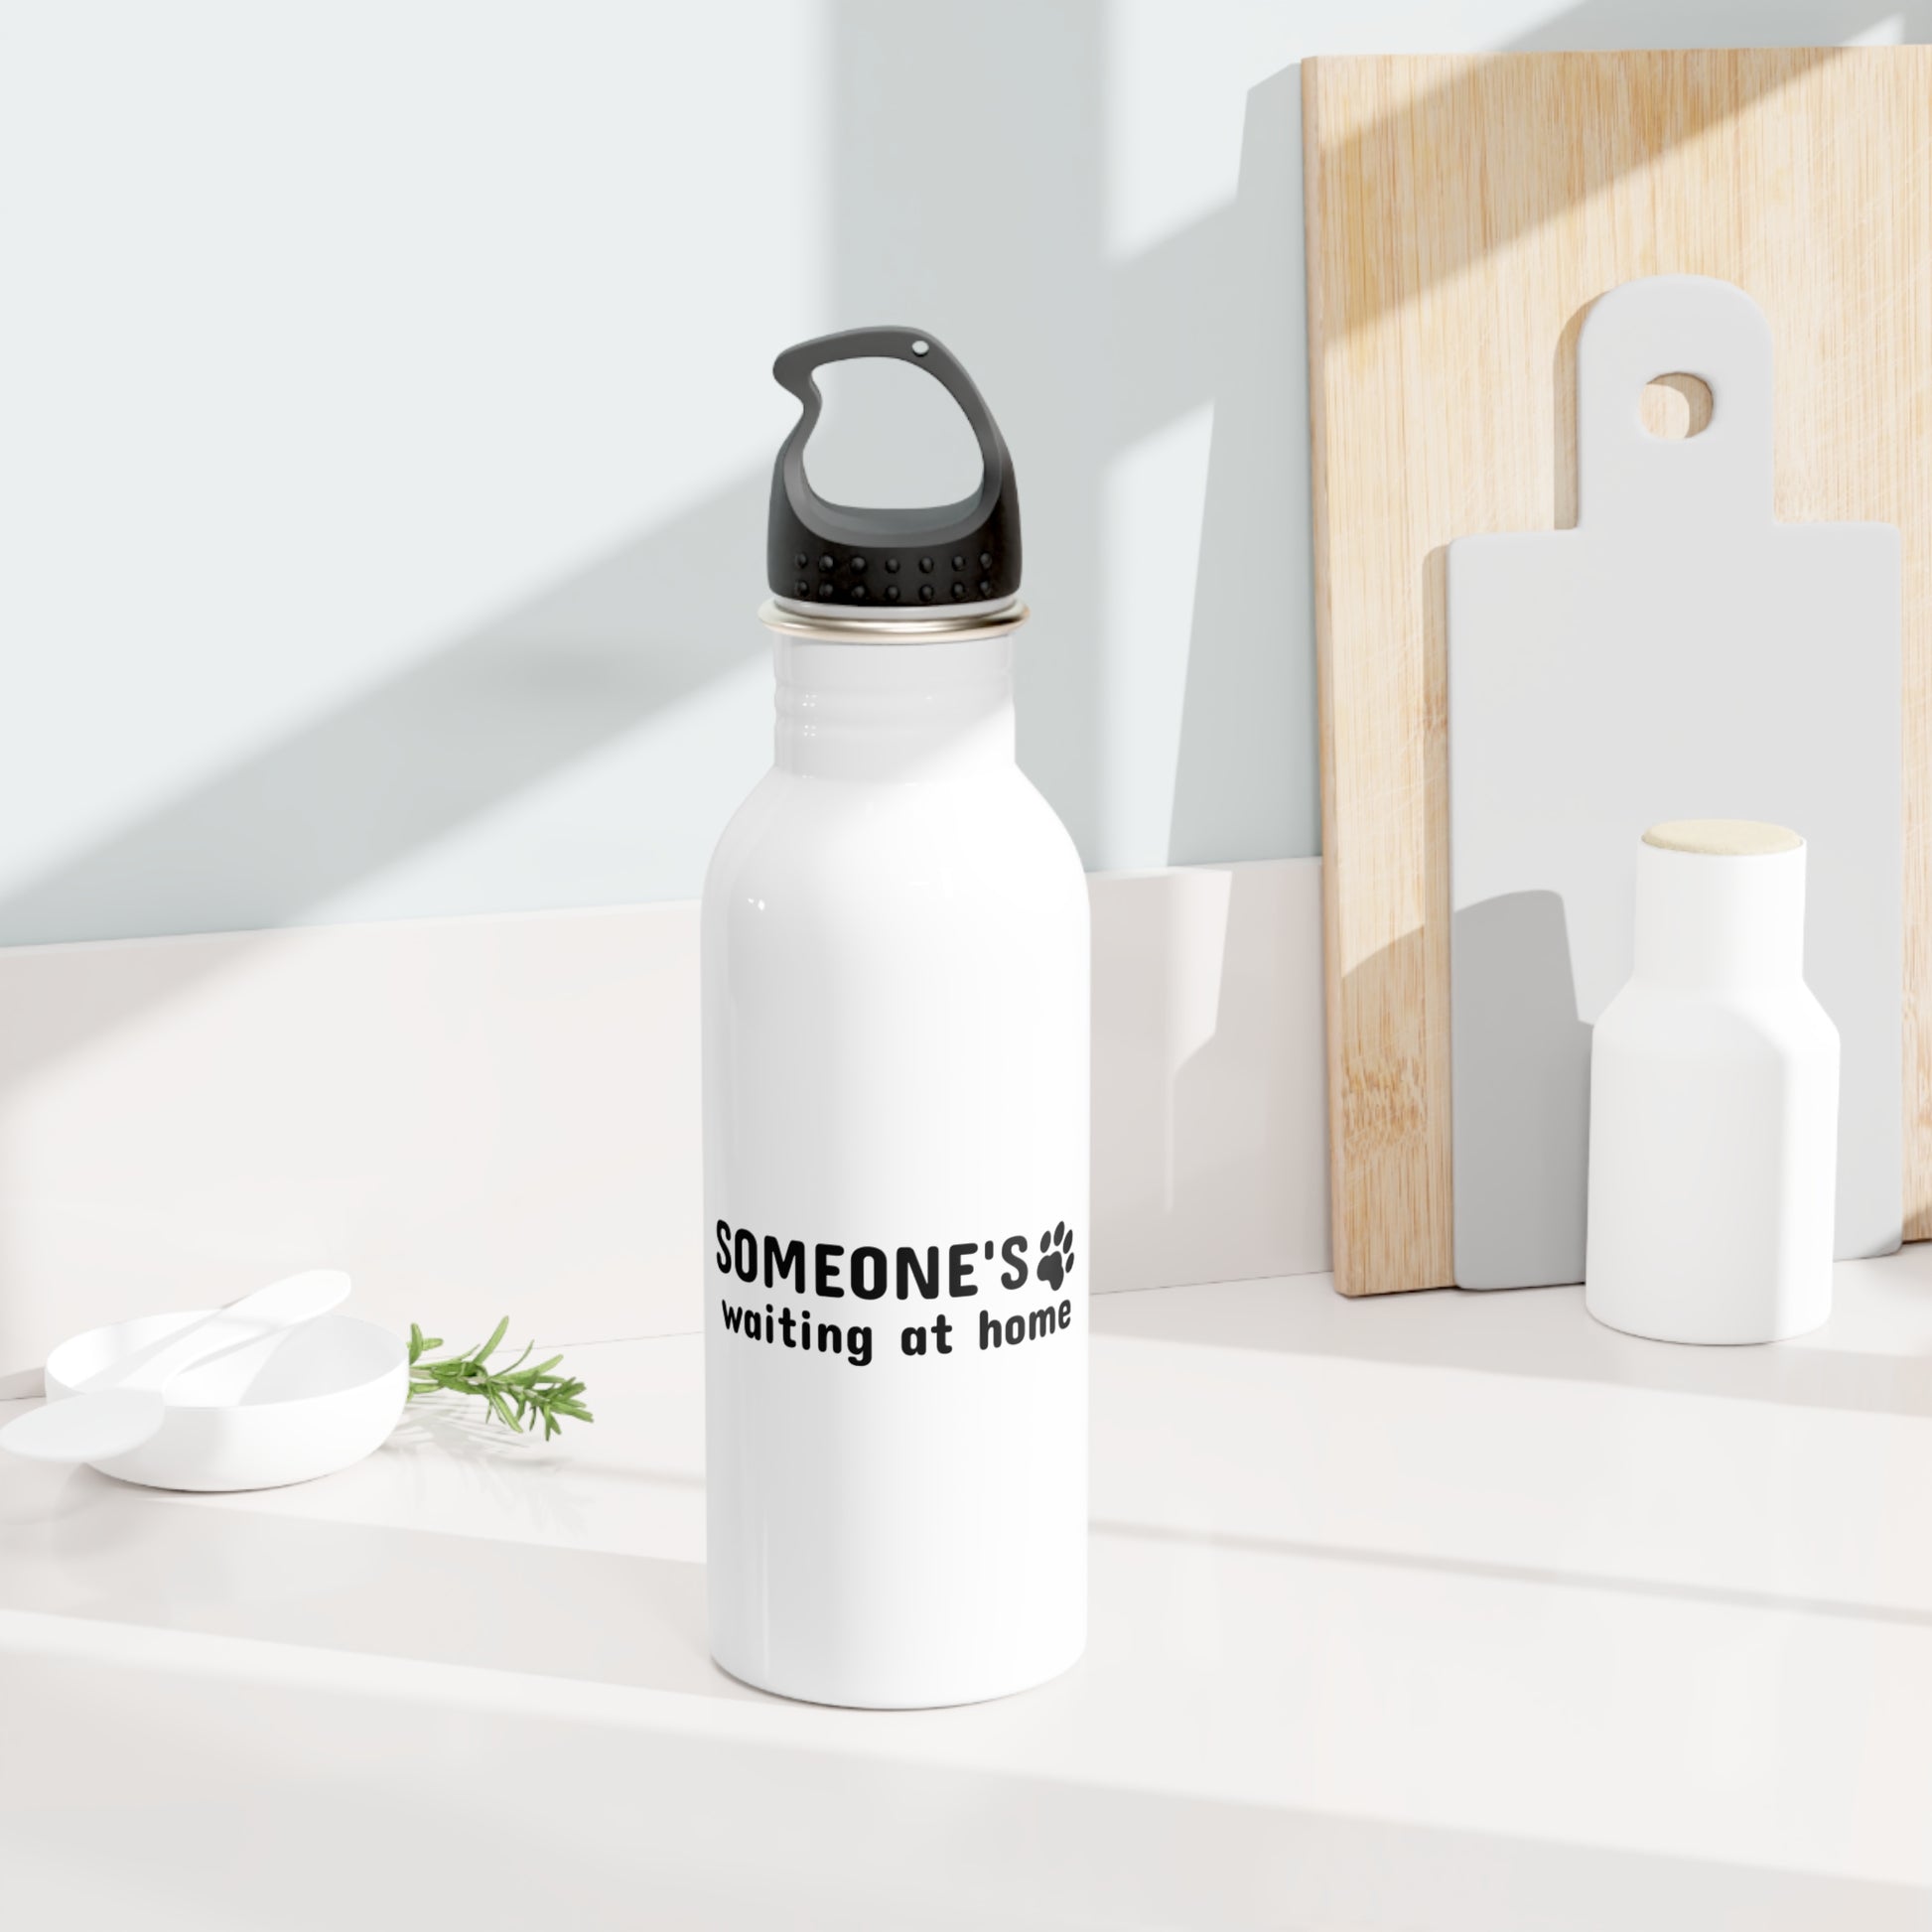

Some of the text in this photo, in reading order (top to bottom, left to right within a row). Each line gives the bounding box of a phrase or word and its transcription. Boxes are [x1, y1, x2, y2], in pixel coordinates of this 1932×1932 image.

[716, 1219, 1029, 1301] SOMEONE'S
[721, 1299, 1072, 1367] waiting at home
